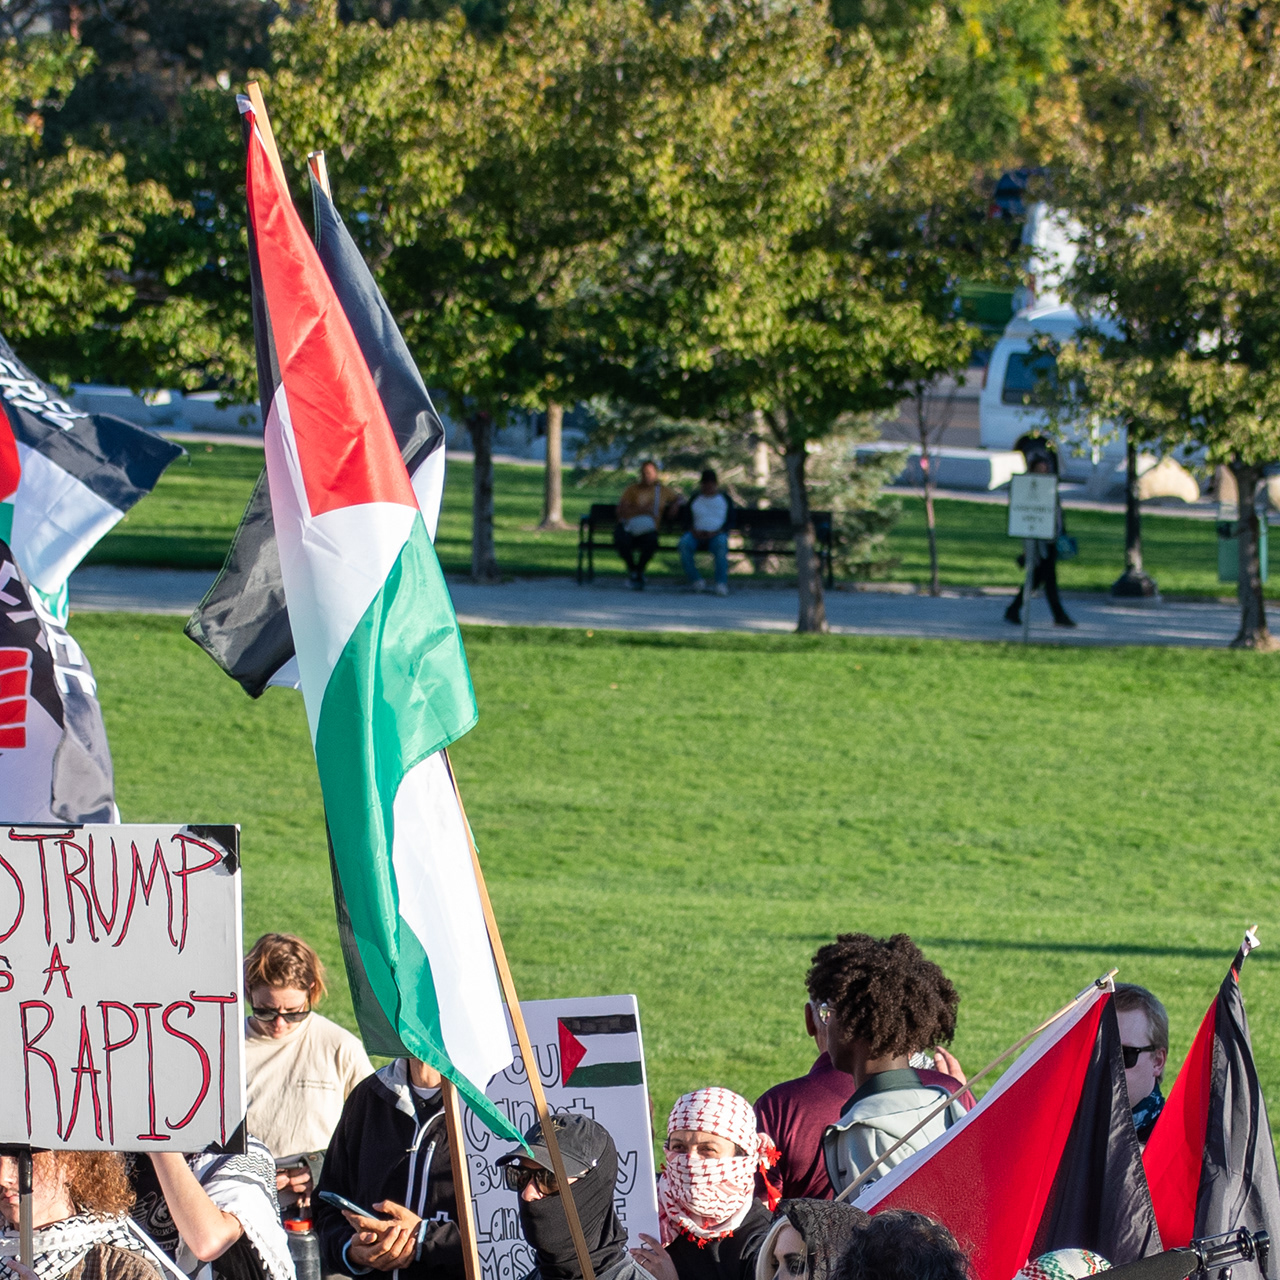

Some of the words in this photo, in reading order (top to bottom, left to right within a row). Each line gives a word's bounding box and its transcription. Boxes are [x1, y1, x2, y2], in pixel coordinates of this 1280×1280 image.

[8, 827, 224, 954] TRUMP
[42, 942, 74, 998] A
[19, 990, 238, 1147] RAPIST
